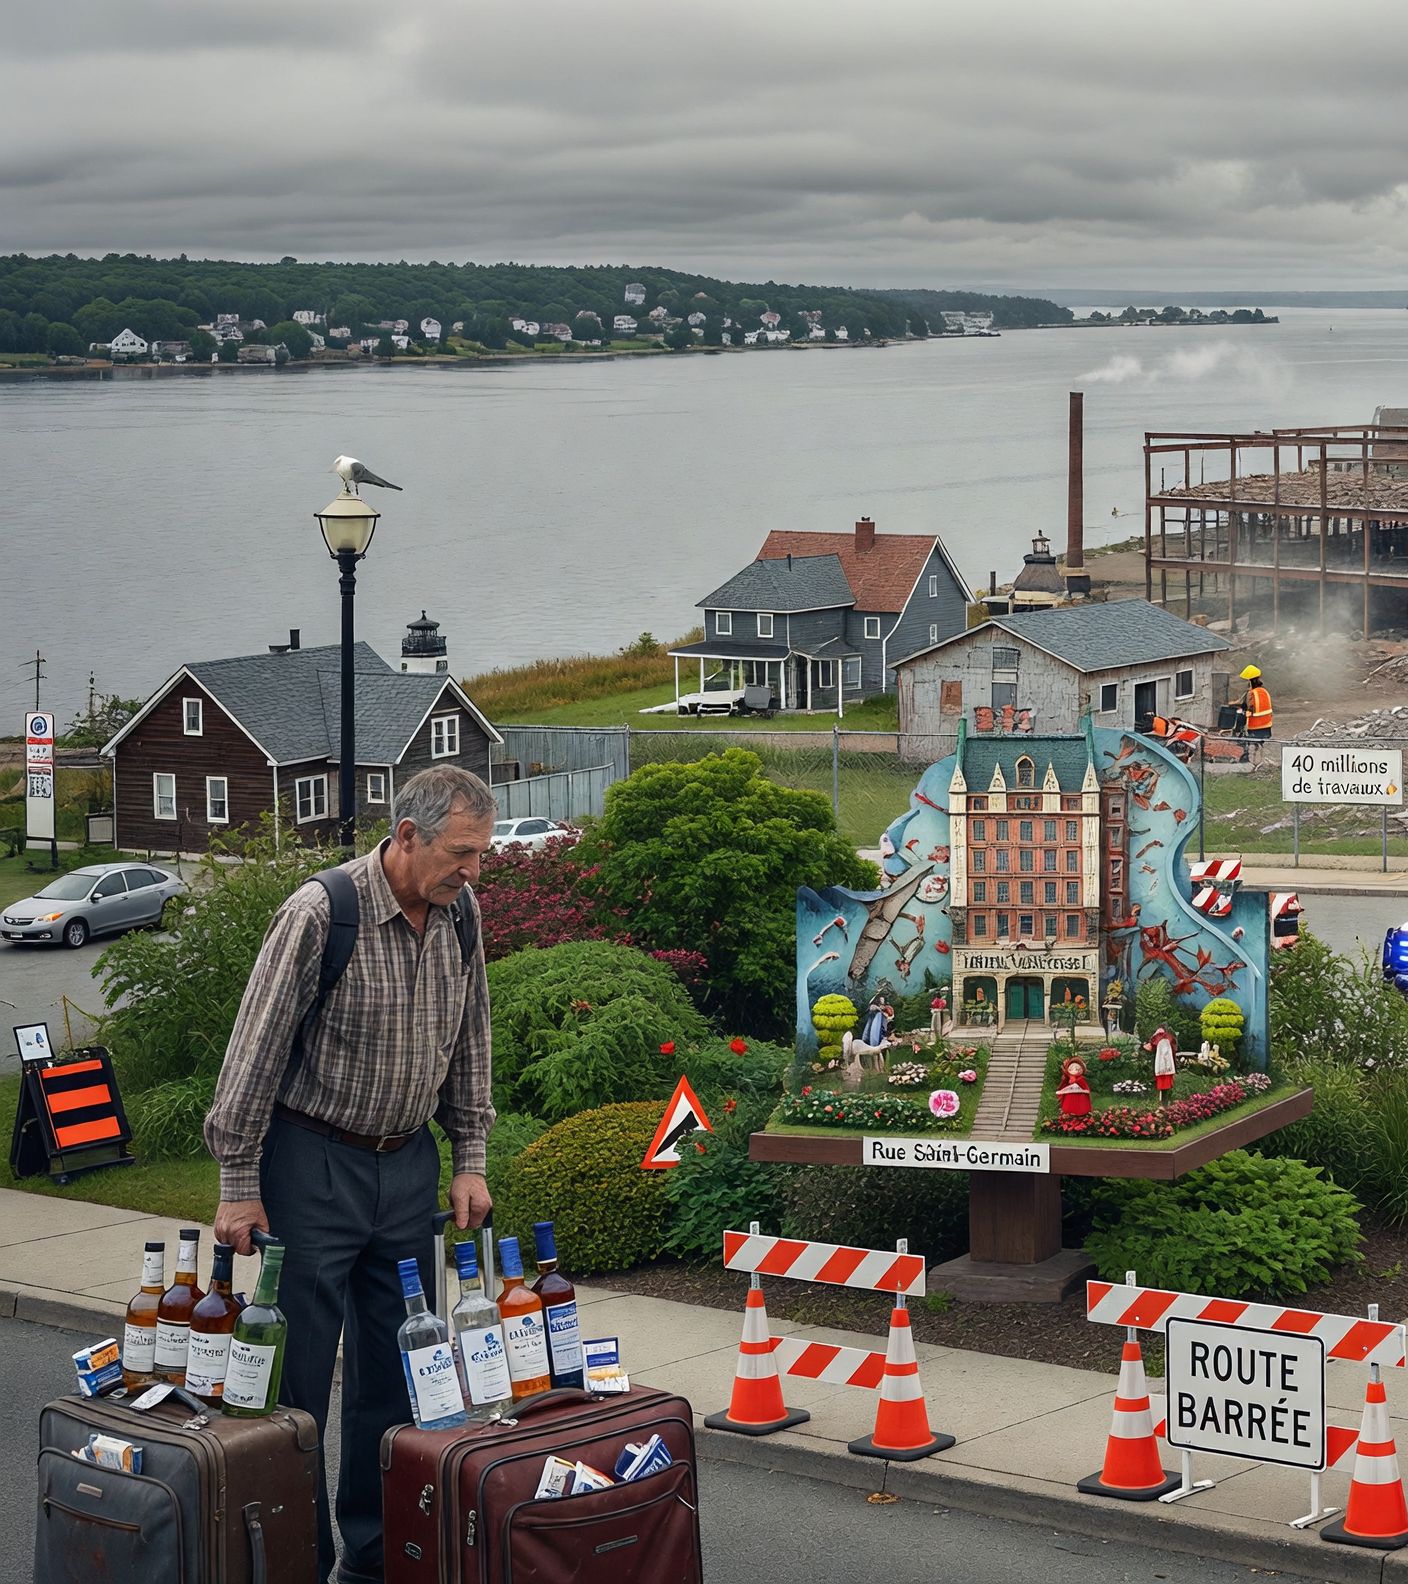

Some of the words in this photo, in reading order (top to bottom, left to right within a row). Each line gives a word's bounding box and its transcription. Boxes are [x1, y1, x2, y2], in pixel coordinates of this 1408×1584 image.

[1291, 754, 1314, 773] 40
[1321, 753, 1388, 774] millions
[1292, 776, 1312, 794] de
[1318, 777, 1384, 795] travaux
[872, 1141, 906, 1160] Rue
[1190, 1340, 1299, 1392] ROUTE
[1178, 1391, 1311, 1448] BARRÉE
